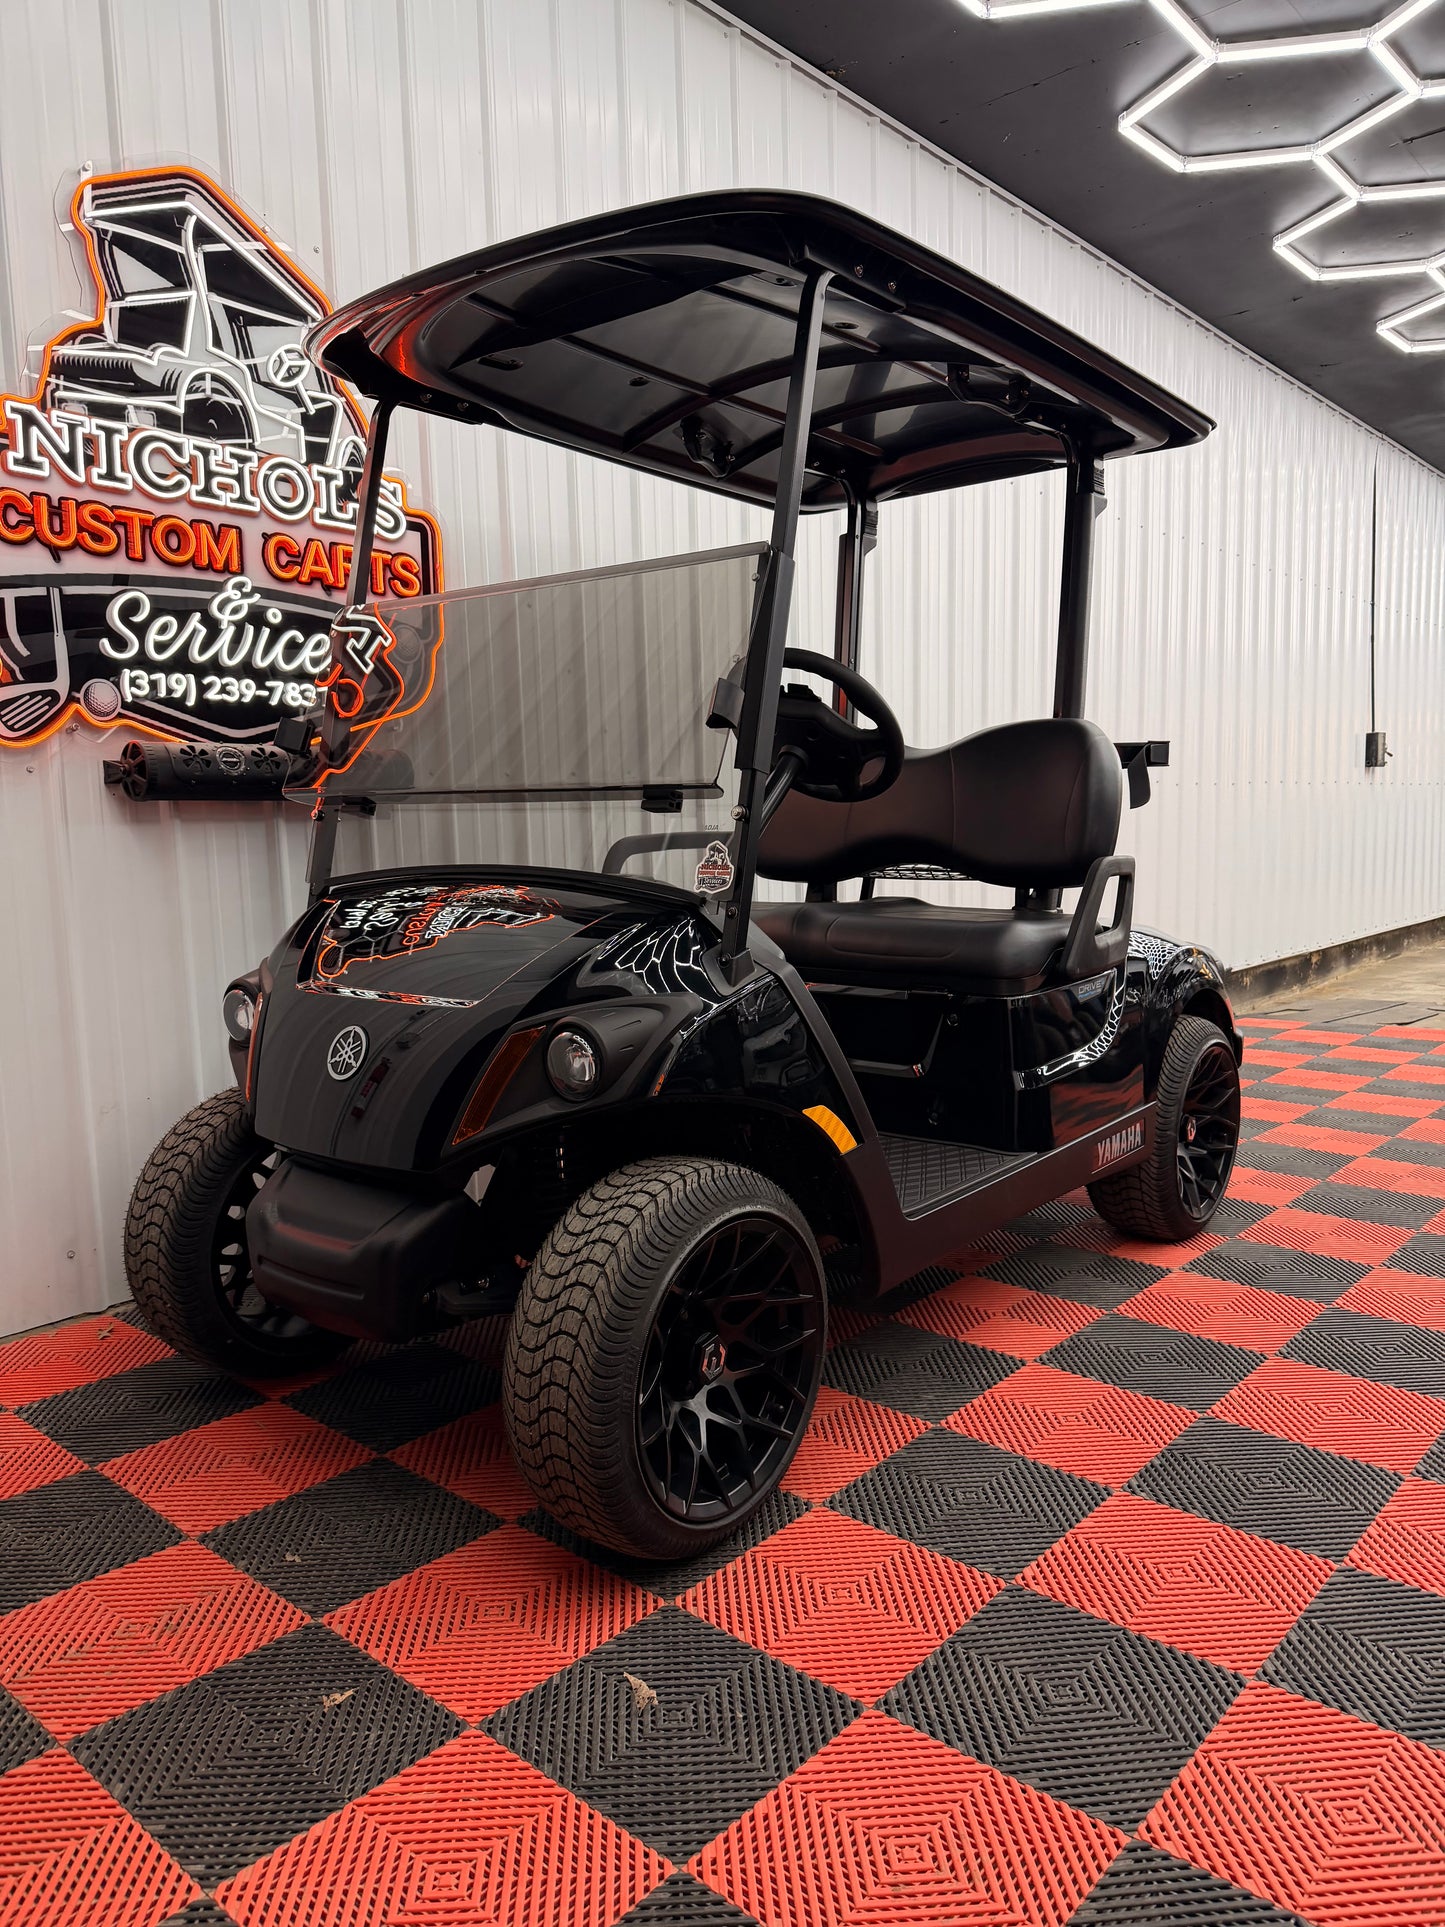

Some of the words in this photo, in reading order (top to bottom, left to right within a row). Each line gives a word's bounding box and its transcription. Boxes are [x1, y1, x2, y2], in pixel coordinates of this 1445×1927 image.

[3, 400, 407, 542] NICHOLS
[0, 487, 243, 574] CUSTOM
[262, 532, 420, 597] CARTS
[99, 589, 332, 674] Service
[208, 575, 261, 628] &
[119, 668, 197, 706] (319)
[1097, 1123, 1142, 1166] YAMAHA
